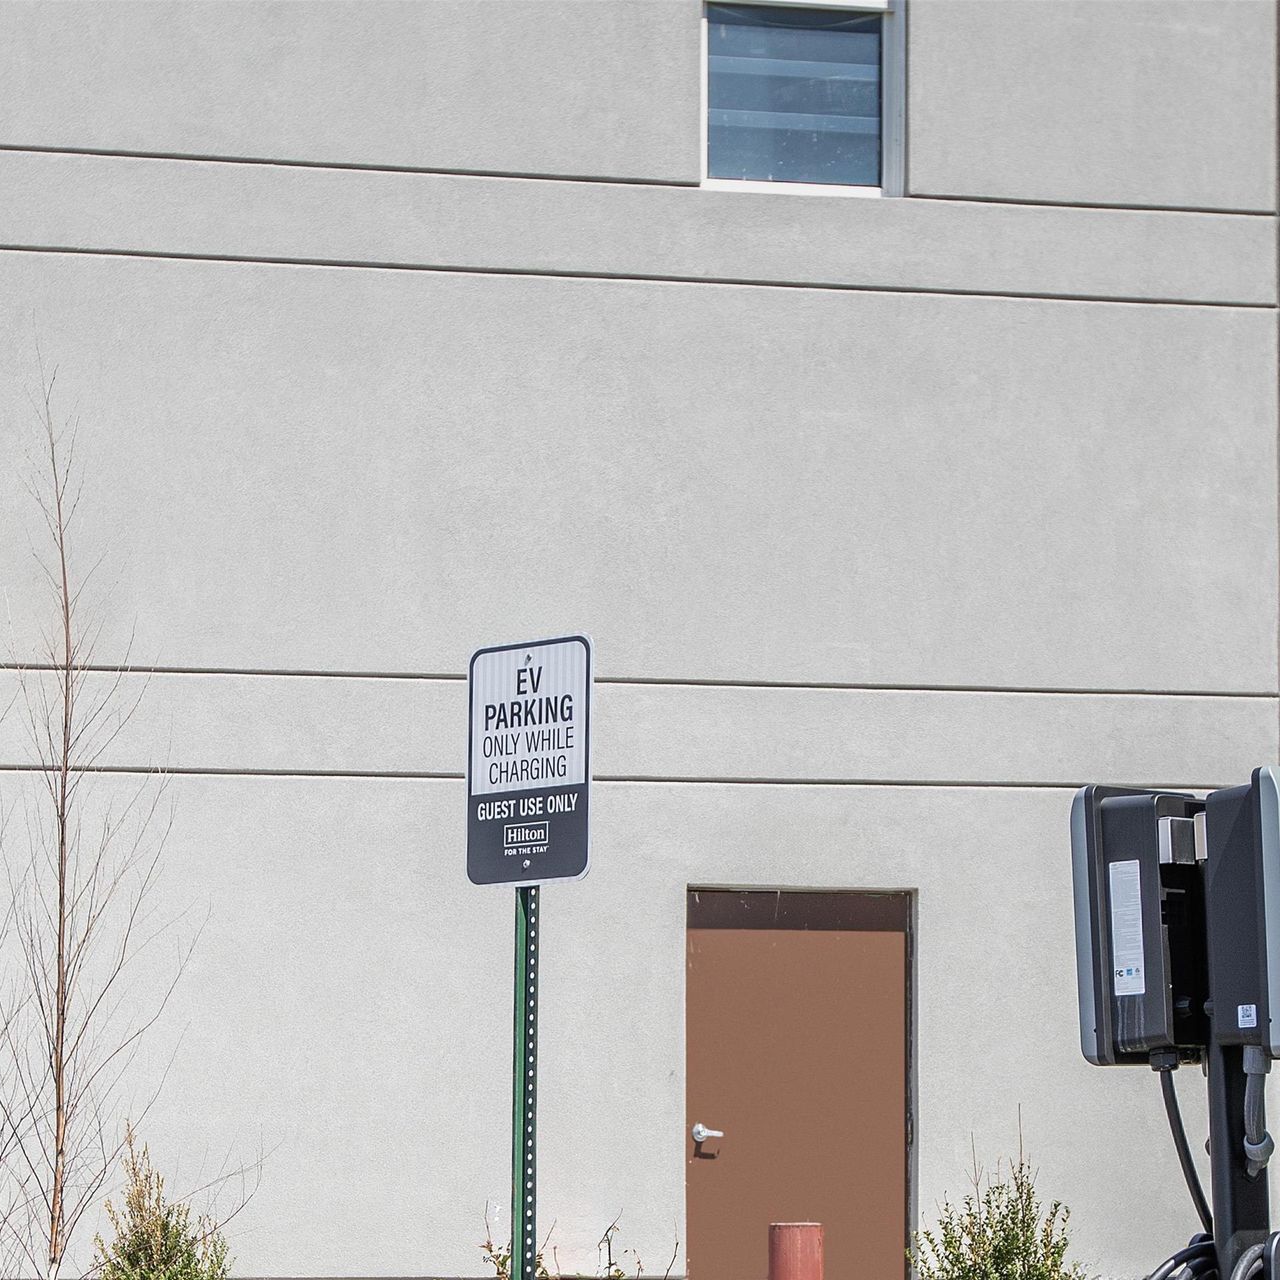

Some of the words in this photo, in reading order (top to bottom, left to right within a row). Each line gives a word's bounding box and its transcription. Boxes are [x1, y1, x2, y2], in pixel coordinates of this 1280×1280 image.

[516, 666, 542, 695] EV
[485, 694, 573, 731] PARKING
[483, 732, 520, 758] ONLY
[526, 726, 574, 753] WHILE
[489, 755, 567, 784] CHARGING
[477, 800, 516, 821] GUEST
[520, 796, 543, 816] USE
[547, 793, 578, 813] ONLY
[507, 825, 545, 842] Hilton
[504, 848, 517, 856] FOR
[518, 846, 531, 855] THE
[532, 845, 547, 854] STAY
